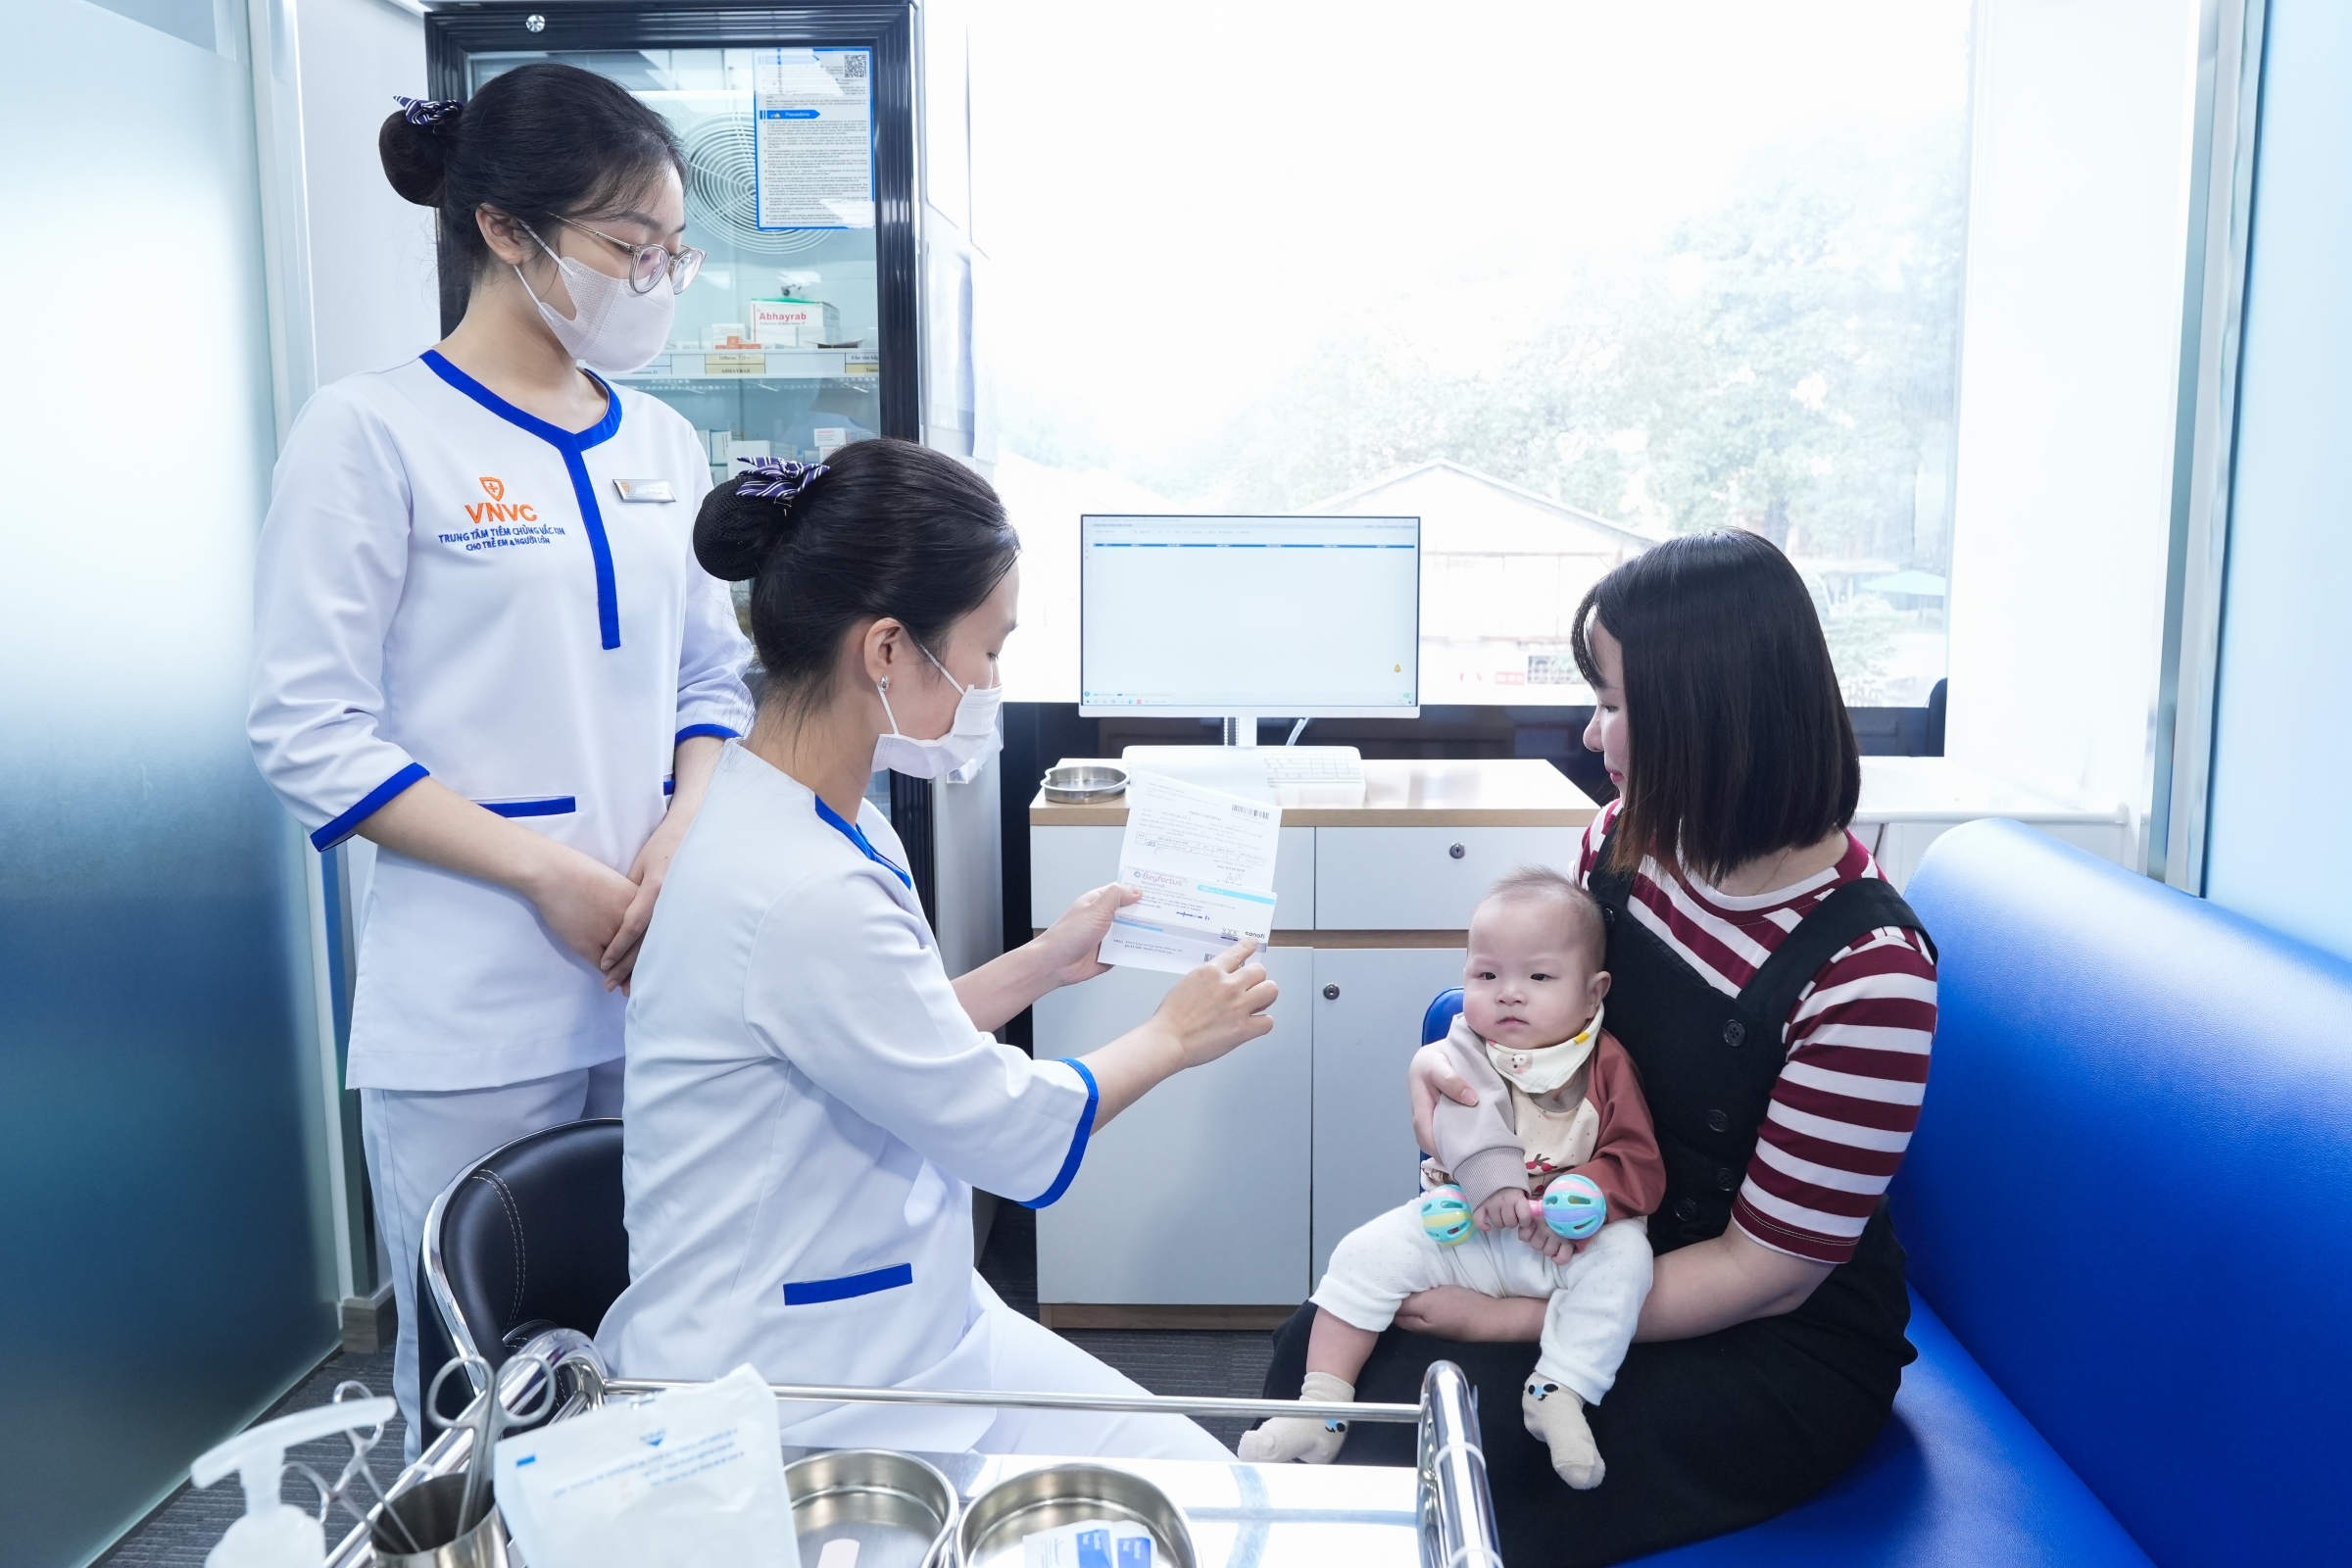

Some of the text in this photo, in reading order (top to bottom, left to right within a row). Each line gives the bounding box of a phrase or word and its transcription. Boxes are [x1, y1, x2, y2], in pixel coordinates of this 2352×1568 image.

[759, 312, 807, 321] Abhayrab
[465, 502, 538, 524] VNVC
[438, 532, 470, 544] TRUNG
[470, 528, 489, 540] TÂM
[490, 524, 512, 537] TIÊM
[466, 542, 482, 551] CHO
[483, 537, 497, 549] TRẺ
[497, 539, 509, 548] EM
[514, 535, 537, 545] NGƯỜI
[537, 535, 551, 544] LỚN
[1142, 872, 1183, 886] Beyfortus
